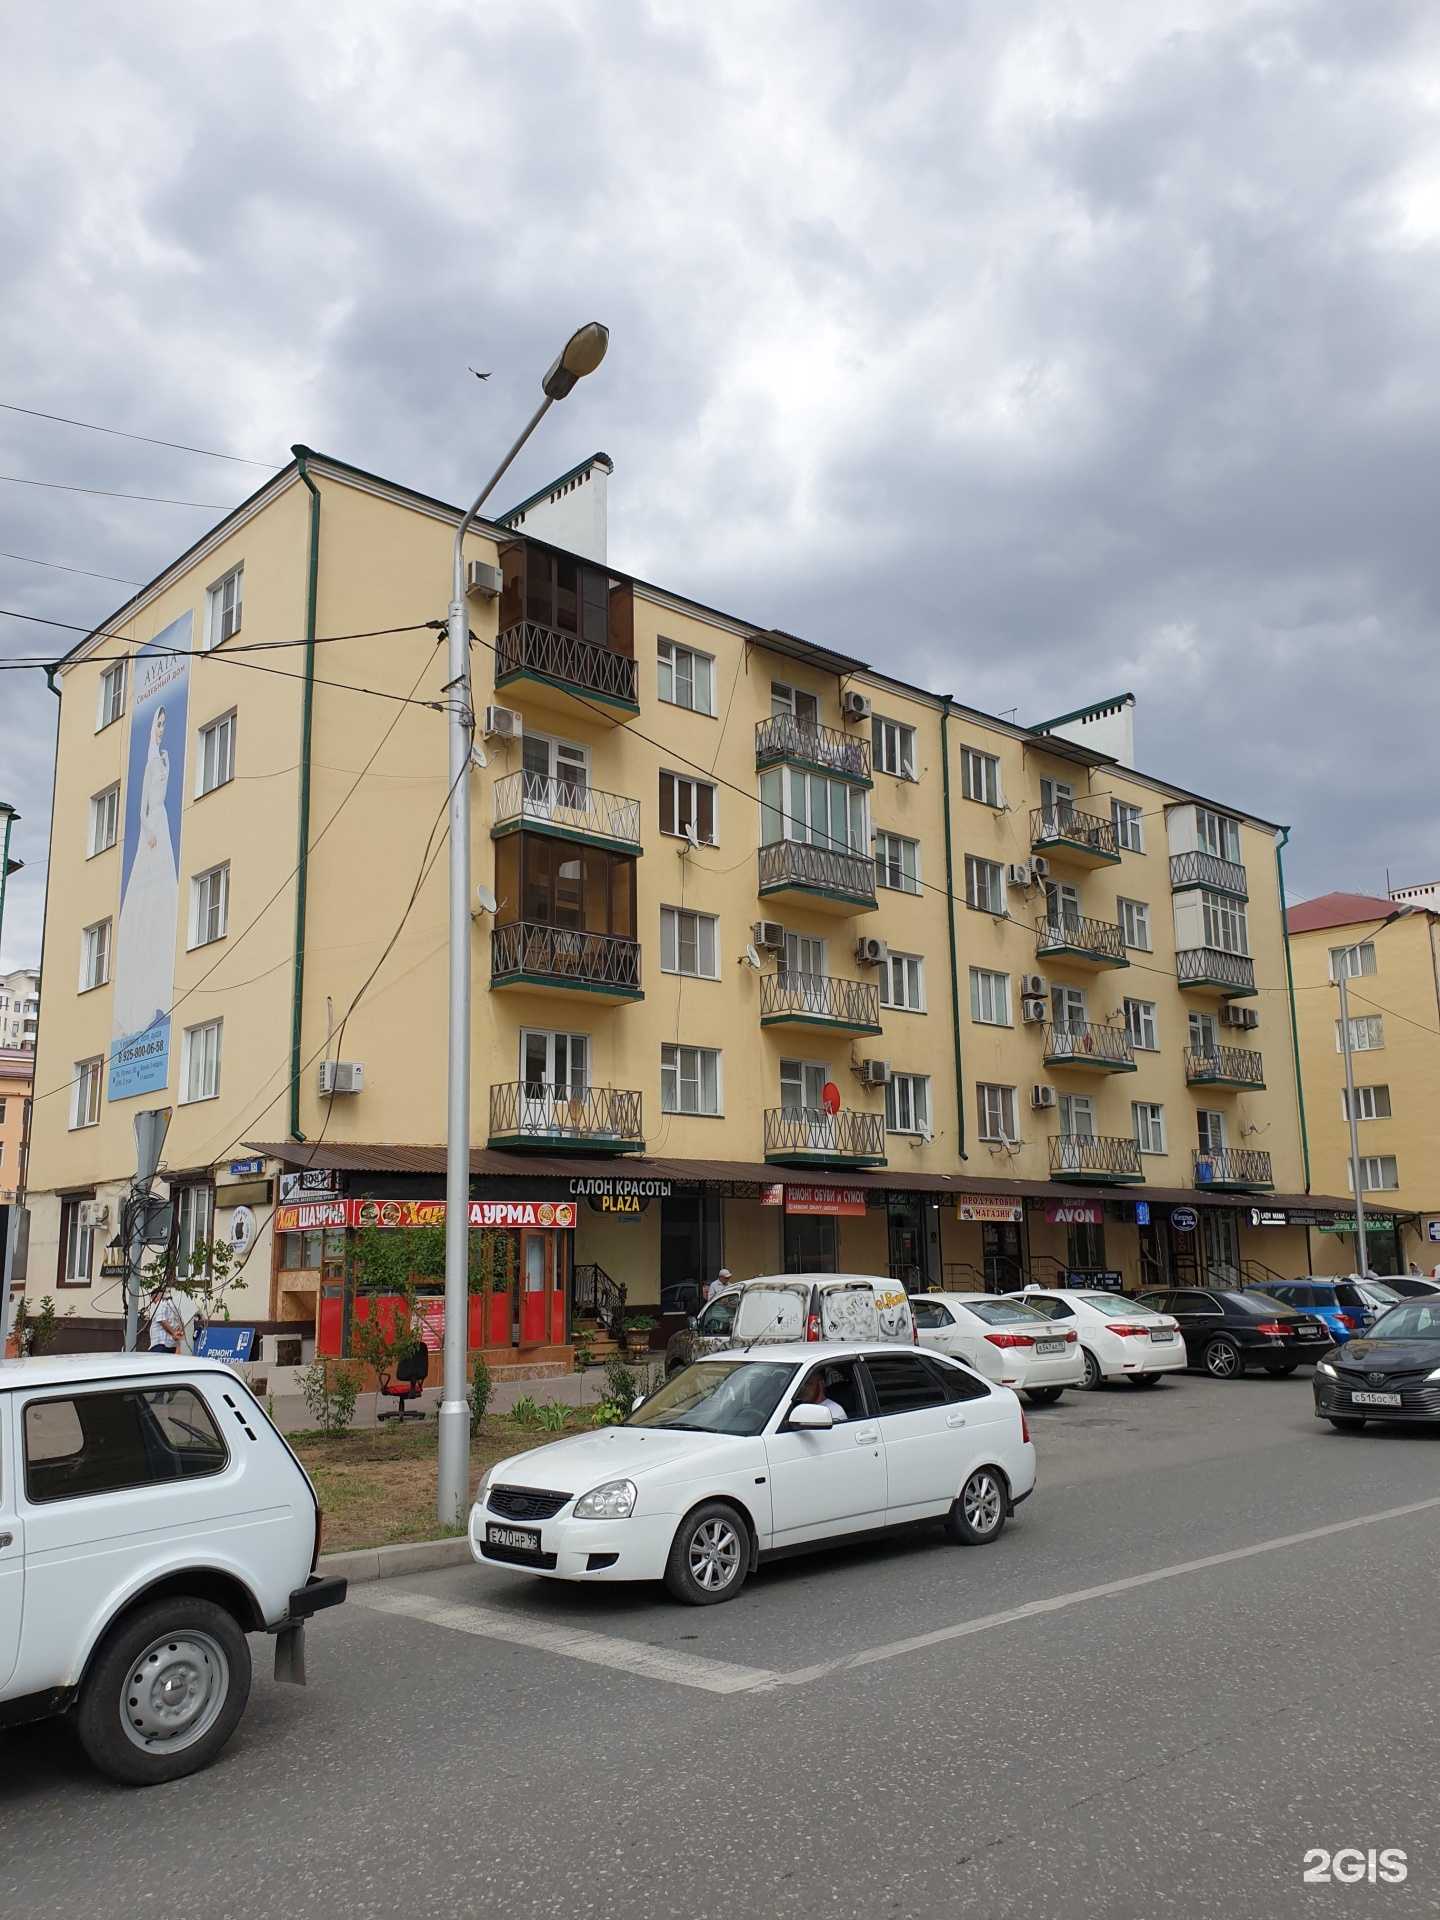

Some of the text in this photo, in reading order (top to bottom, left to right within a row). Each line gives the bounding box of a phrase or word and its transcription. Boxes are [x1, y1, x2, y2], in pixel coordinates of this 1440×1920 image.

[569, 1179, 671, 1196] САЛОН КРАСОТЫ
[788, 1187, 812, 1201] РЕМОНТ
[814, 1189, 835, 1202] ОБУВИ
[843, 1191, 865, 1203] СУМОК
[602, 1196, 640, 1212] PLAZA
[299, 1203, 346, 1227] ШАУРМА
[468, 1204, 536, 1225] АУРМА
[975, 1208, 1010, 1218] МАГАЗИН
[1055, 1208, 1095, 1223] AVON
